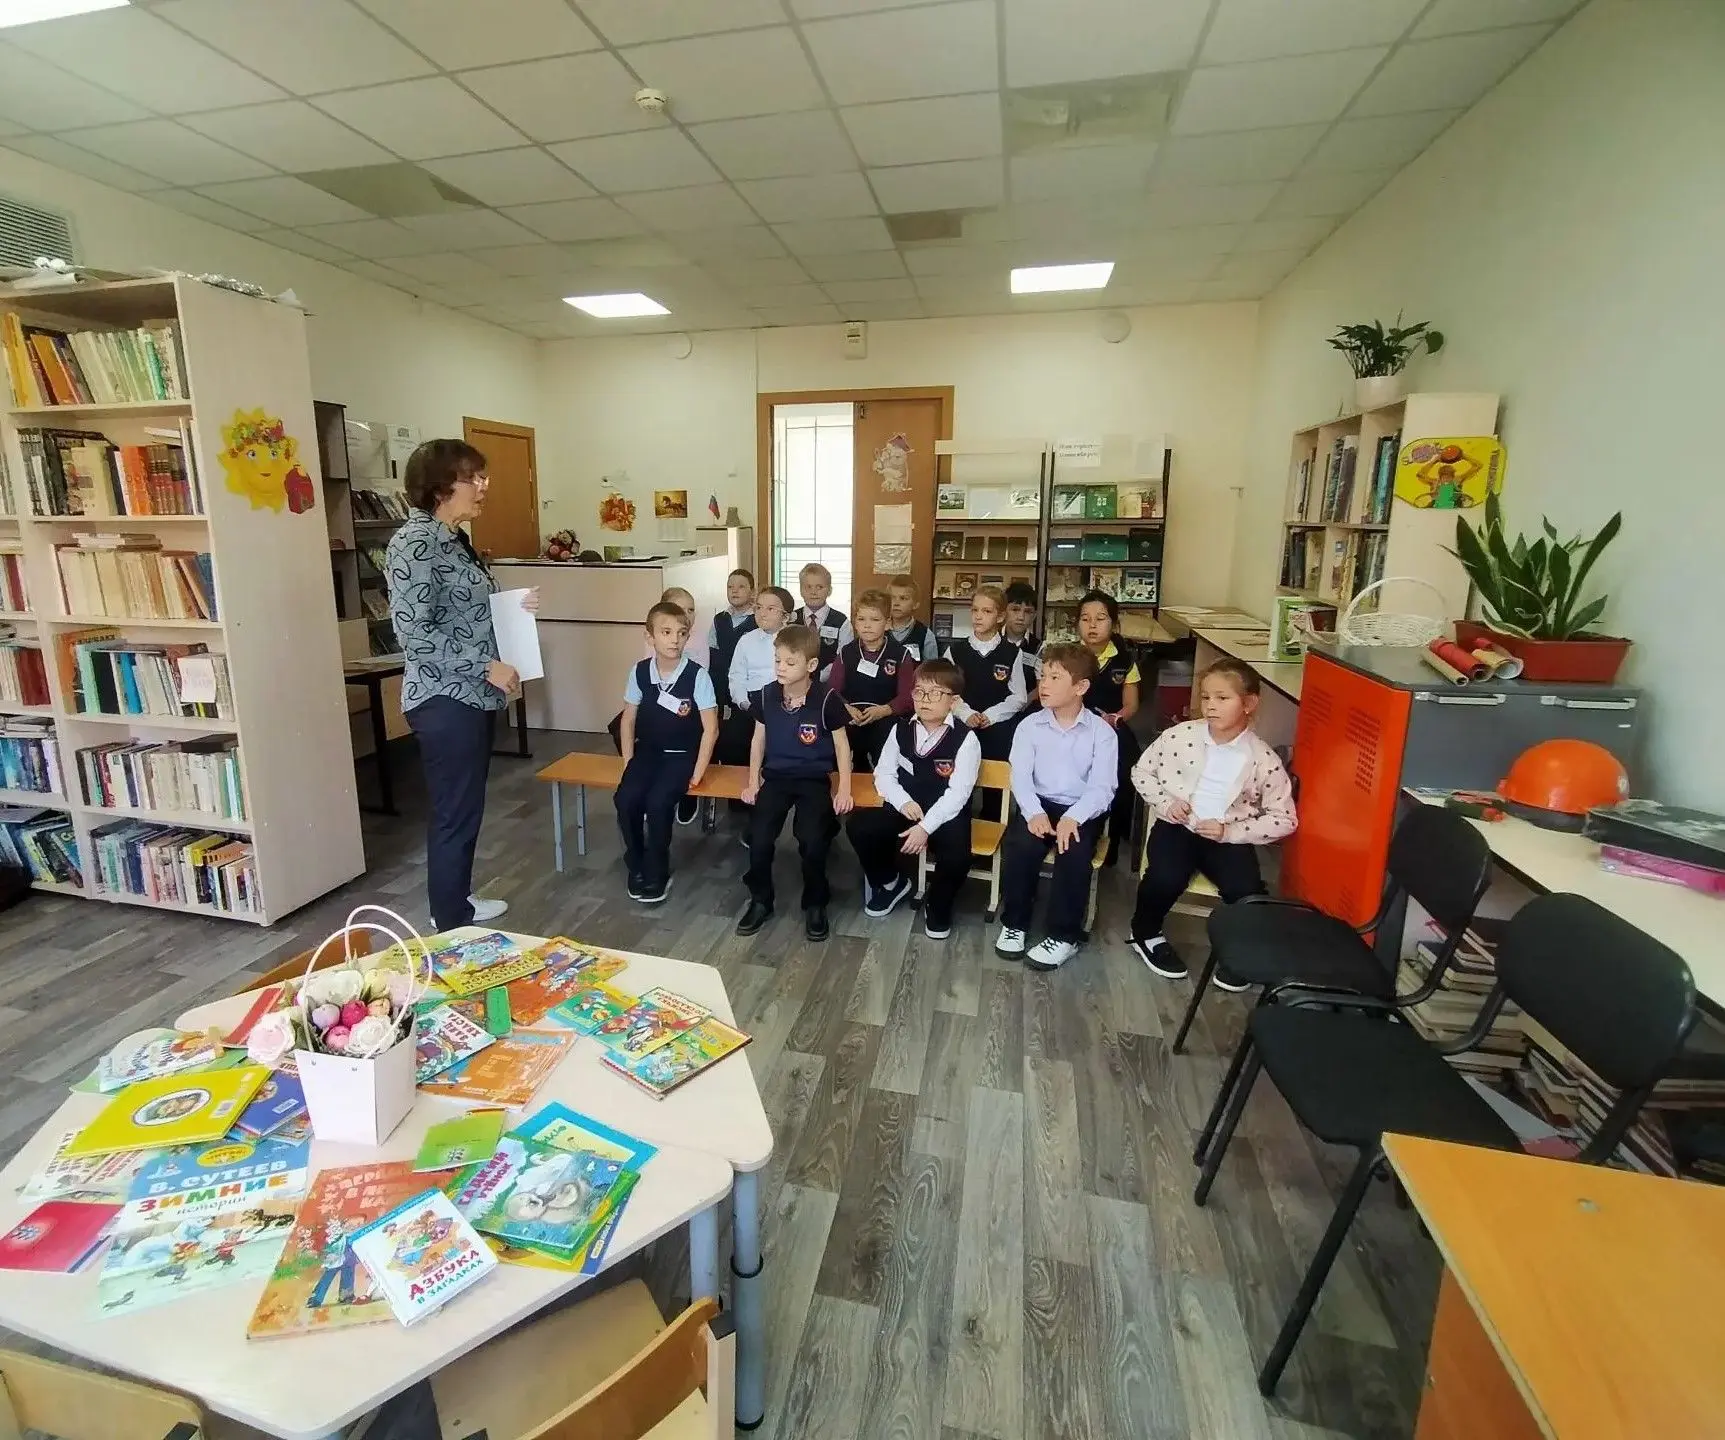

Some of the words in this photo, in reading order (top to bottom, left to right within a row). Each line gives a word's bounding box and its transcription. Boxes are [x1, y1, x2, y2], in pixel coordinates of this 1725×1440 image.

[181, 1160, 287, 1188] СУТЕЕВ
[137, 1174, 289, 1213] ЗИМНИЕ
[177, 1196, 246, 1215] истории
[408, 1250, 480, 1301] АЗБУКА
[427, 1260, 484, 1296] ЗАГАДКАХ
